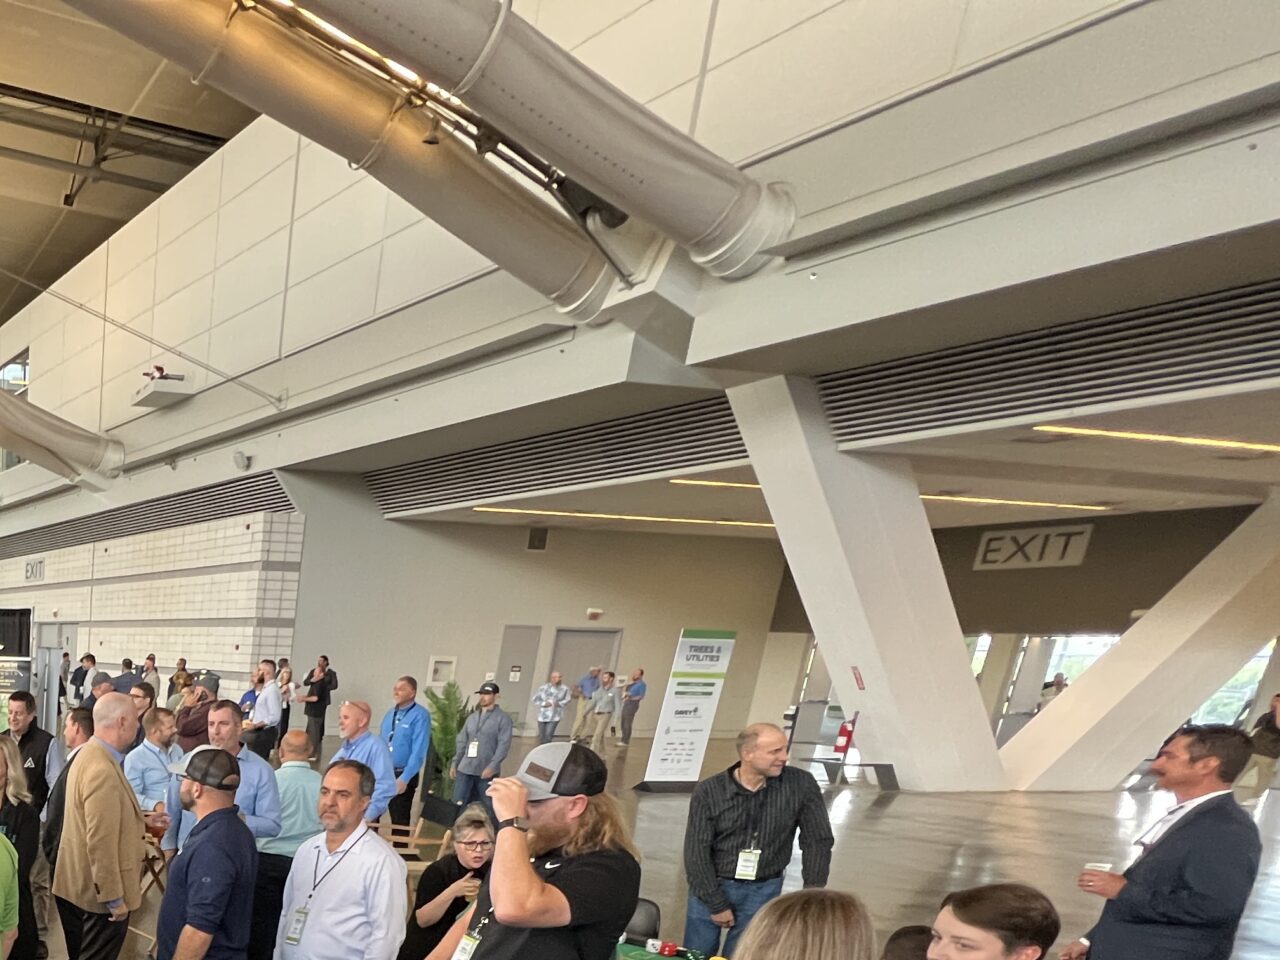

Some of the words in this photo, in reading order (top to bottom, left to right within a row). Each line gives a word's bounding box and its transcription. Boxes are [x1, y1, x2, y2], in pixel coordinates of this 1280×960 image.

[981, 531, 1085, 564] EXIT
[25, 561, 44, 579] EXIT
[688, 645, 714, 653] TREES
[685, 654, 721, 662] UTILITIES
